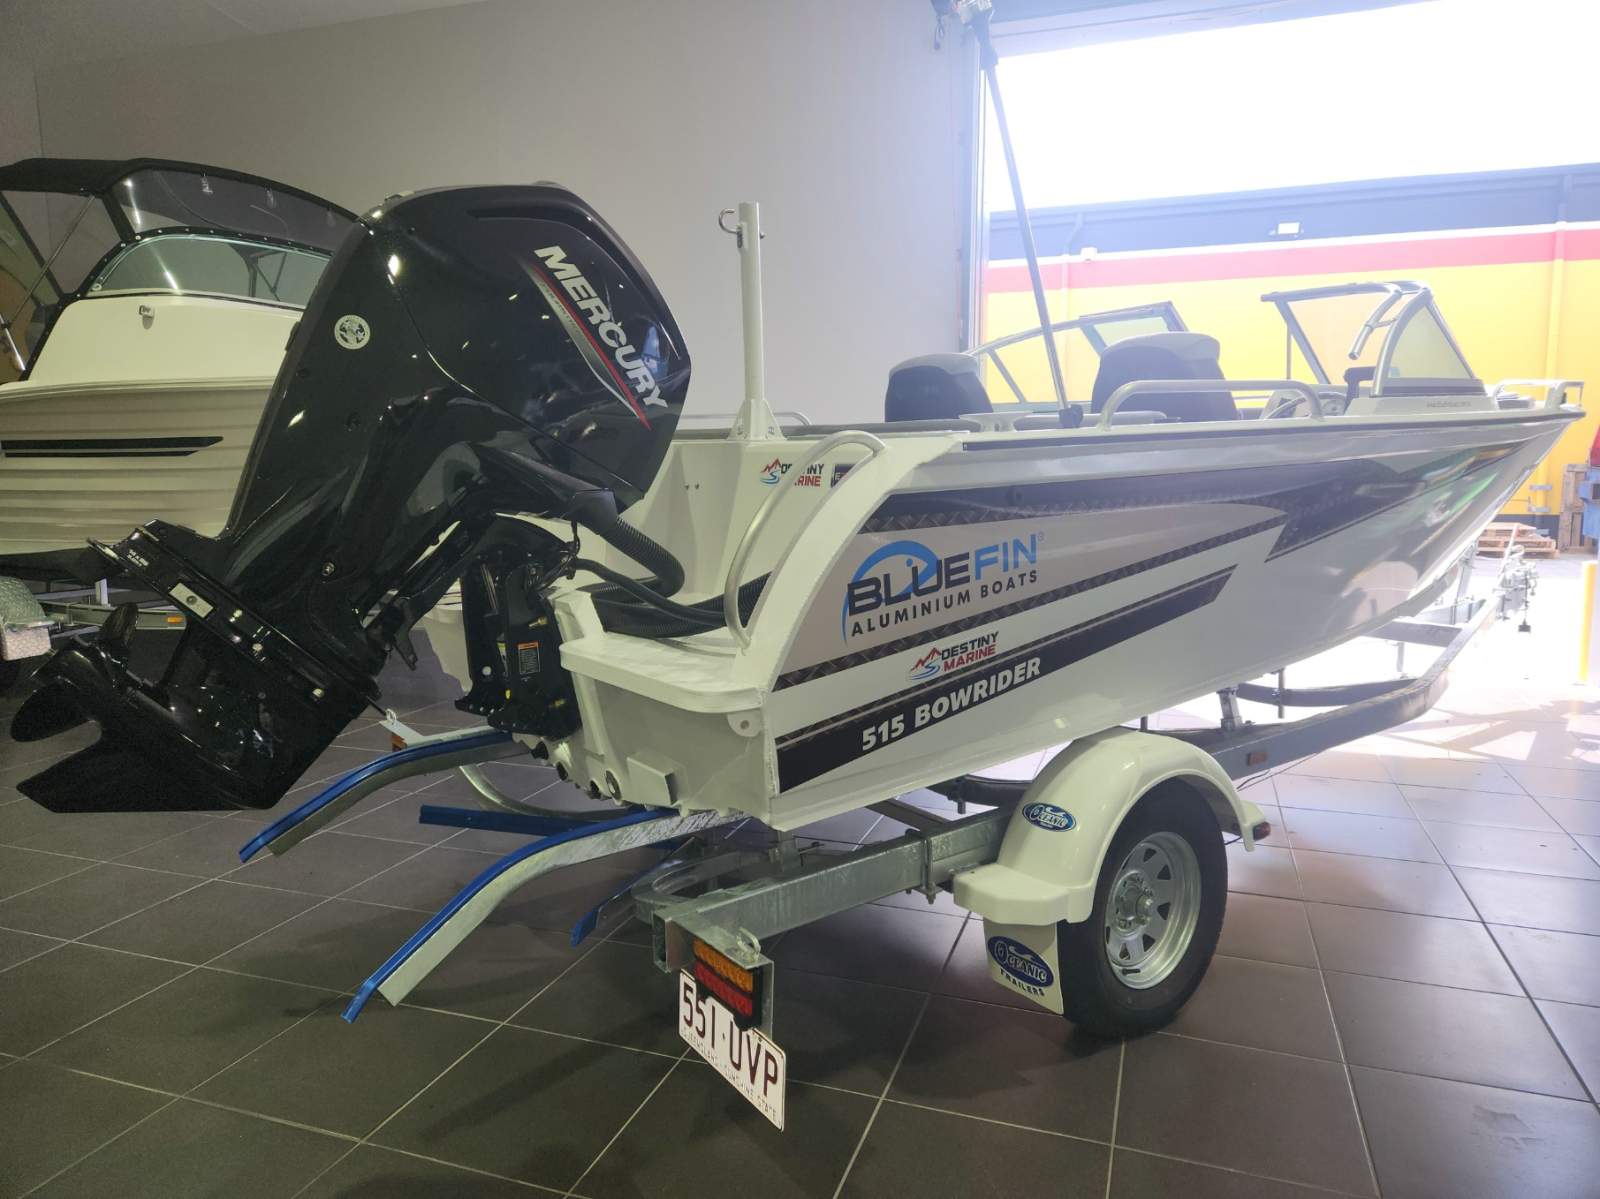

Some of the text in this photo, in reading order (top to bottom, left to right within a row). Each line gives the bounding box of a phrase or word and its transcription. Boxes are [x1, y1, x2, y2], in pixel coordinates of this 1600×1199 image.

[534, 245, 668, 408] MERCURY
[848, 533, 1037, 616] BLUEFIN
[851, 569, 1038, 637] ALUMINIUM BOATS
[941, 631, 999, 661] DESTINY
[943, 643, 996, 672] MARINE
[862, 657, 1041, 751] 515 BOWRIDER
[1000, 968, 1046, 997] TRAILERS
